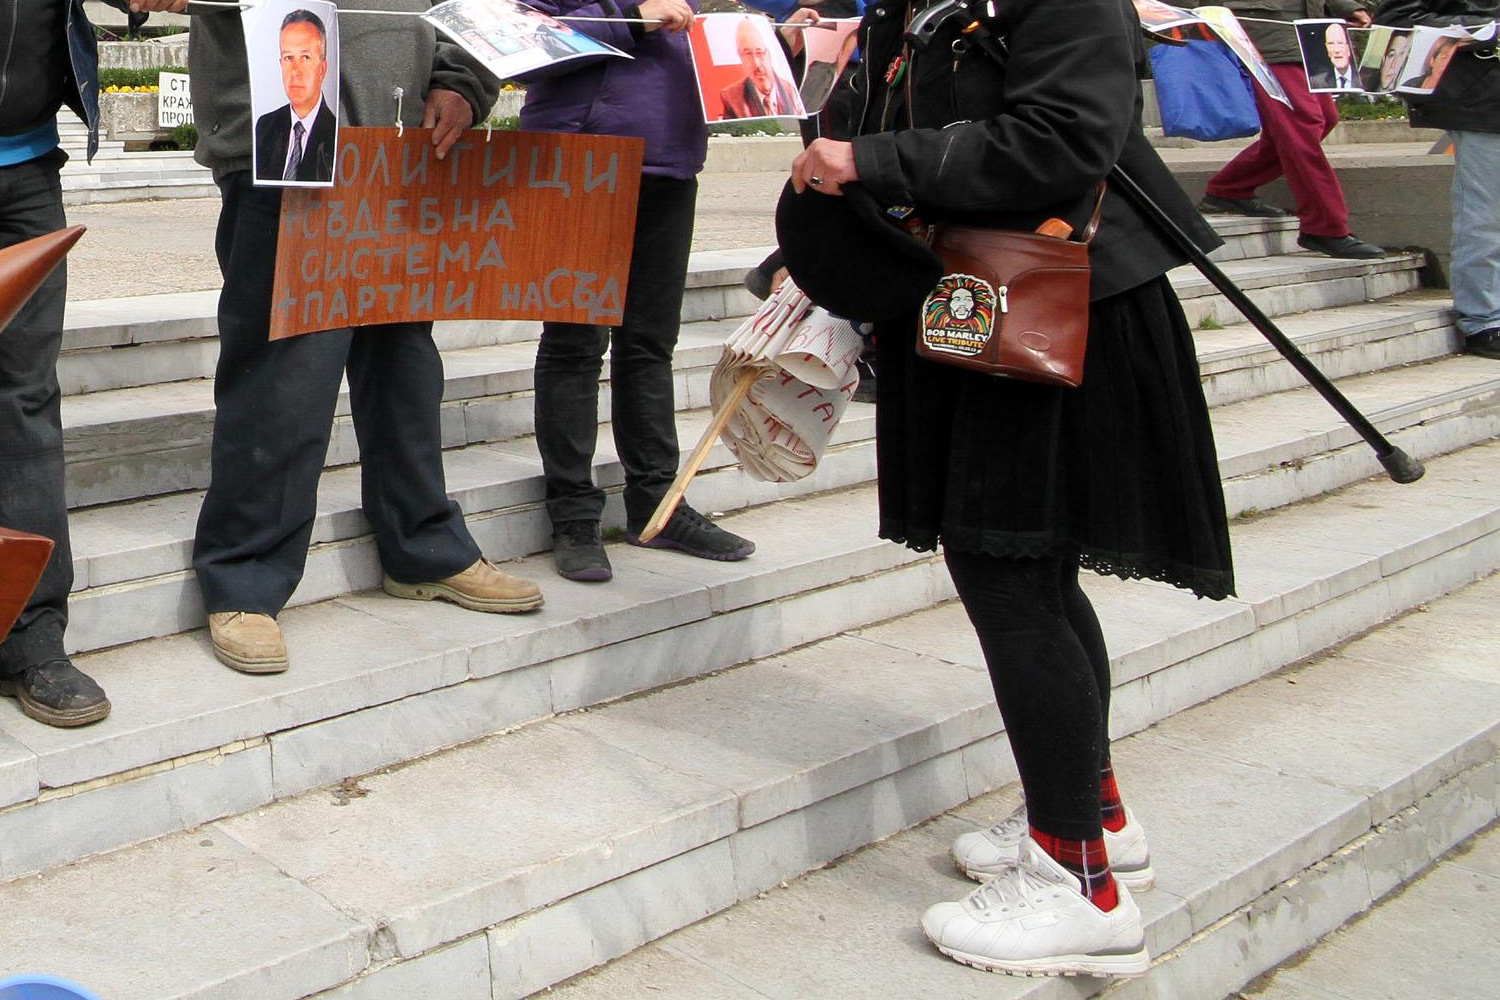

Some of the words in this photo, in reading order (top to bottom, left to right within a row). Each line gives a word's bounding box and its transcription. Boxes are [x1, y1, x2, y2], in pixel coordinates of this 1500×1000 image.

[337, 142, 619, 198] ОЛИТИЦИ
[301, 236, 507, 283] СИСТЕМА
[927, 329, 945, 337] BOB
[947, 331, 988, 341] MARLEY
[928, 336, 946, 344] LIVE
[947, 338, 986, 349] TRIBUTE
